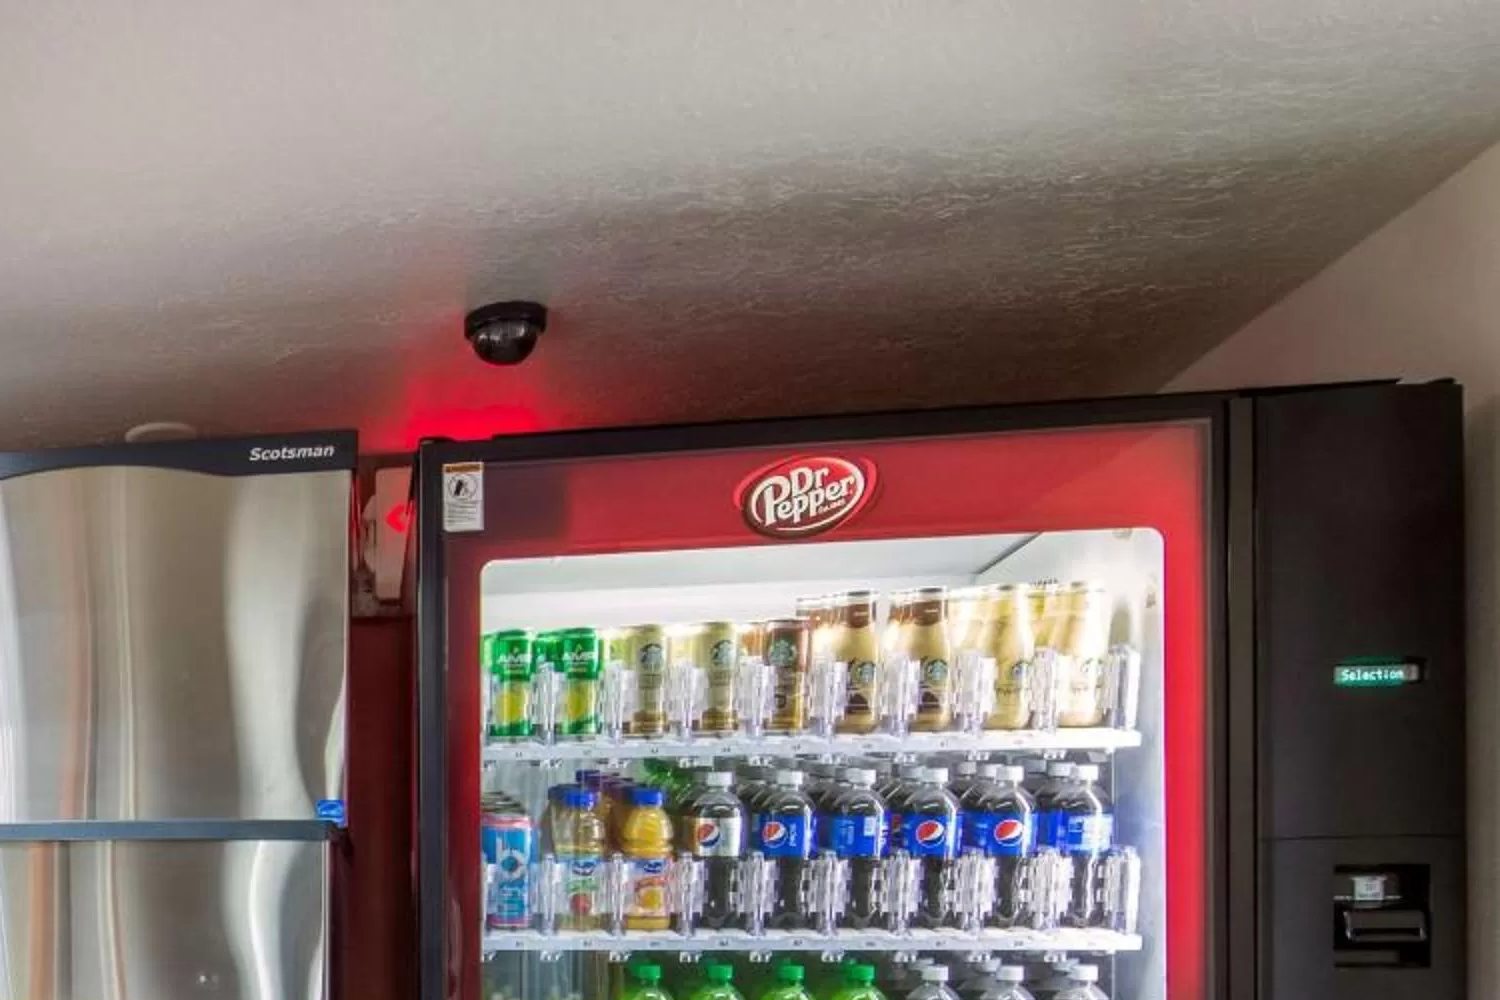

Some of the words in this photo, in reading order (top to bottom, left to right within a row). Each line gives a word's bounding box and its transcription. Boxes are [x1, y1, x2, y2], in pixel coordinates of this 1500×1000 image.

[249, 445, 335, 461] Scotsman
[790, 466, 830, 498] Dr
[752, 473, 856, 526] Pepper
